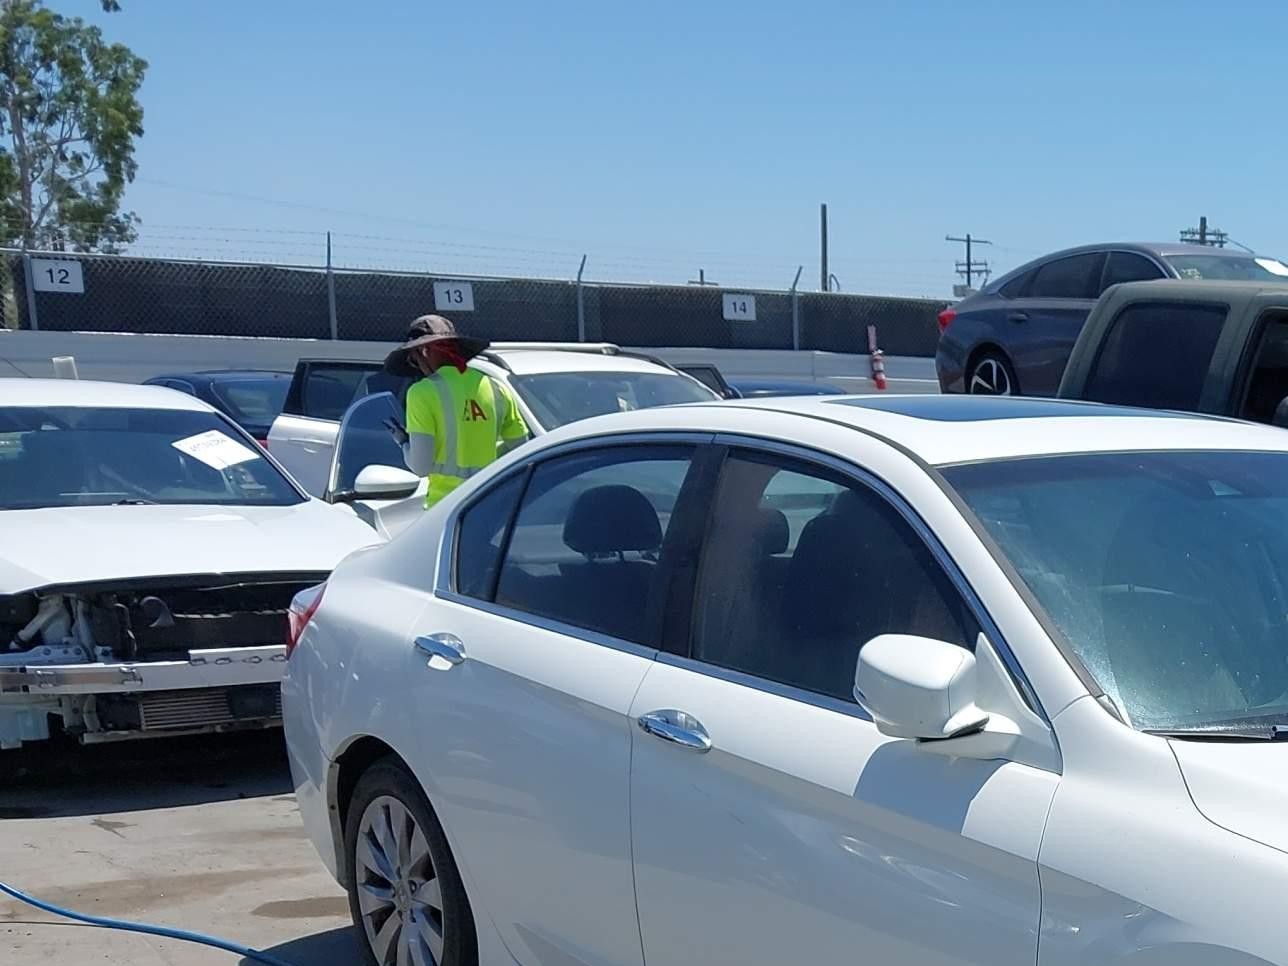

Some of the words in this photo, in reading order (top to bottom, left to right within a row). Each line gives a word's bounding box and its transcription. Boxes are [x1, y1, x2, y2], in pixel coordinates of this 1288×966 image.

[45, 268, 71, 284] 12
[444, 289, 464, 304] 13
[732, 301, 747, 314] 14
